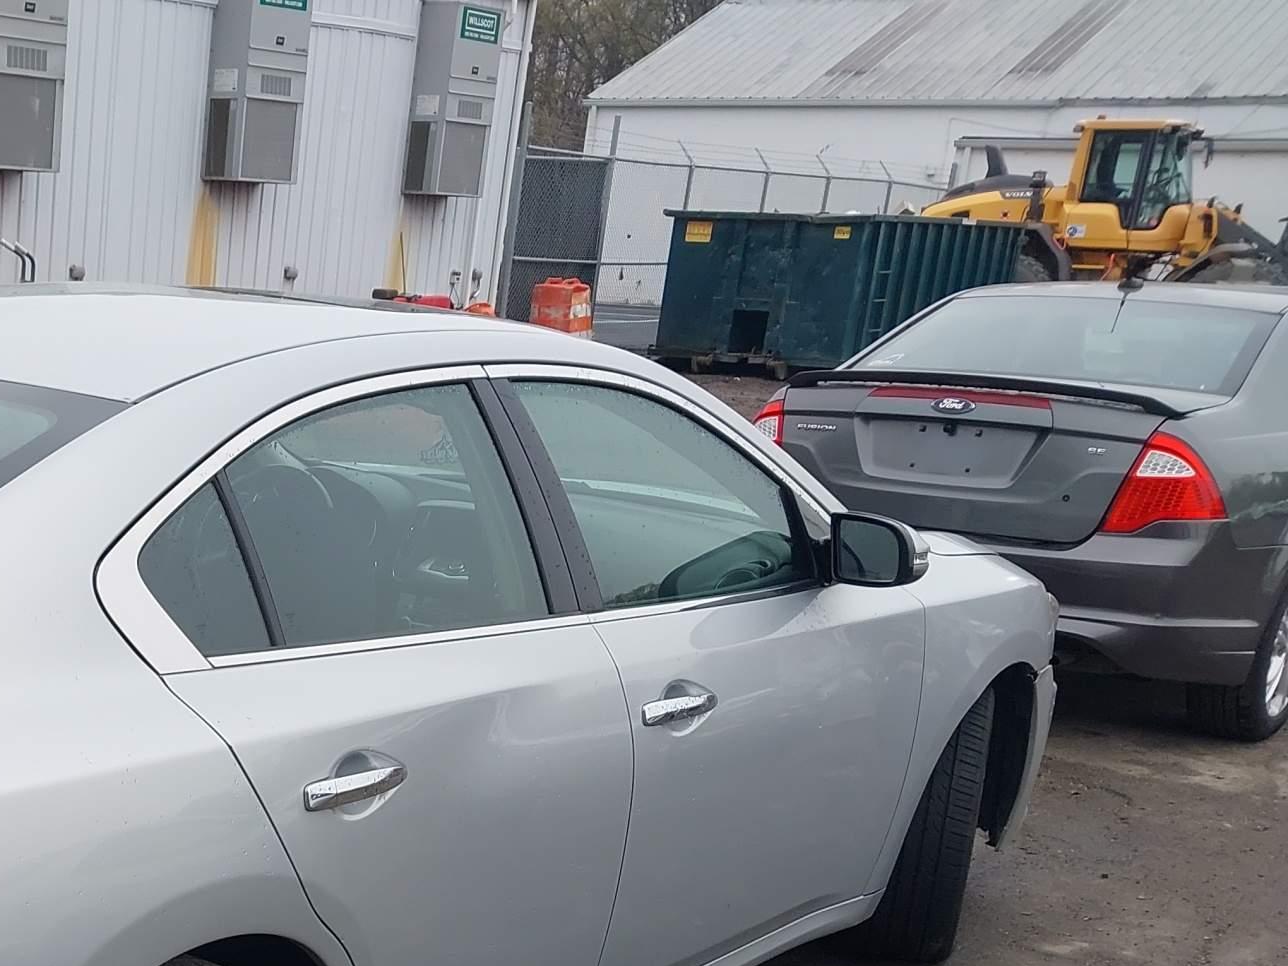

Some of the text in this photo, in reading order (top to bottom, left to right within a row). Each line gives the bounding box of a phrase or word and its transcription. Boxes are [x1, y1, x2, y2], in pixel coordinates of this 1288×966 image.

[468, 16, 495, 29] WILLSCOT
[938, 397, 964, 410] Ford
[797, 423, 837, 432] FUSION
